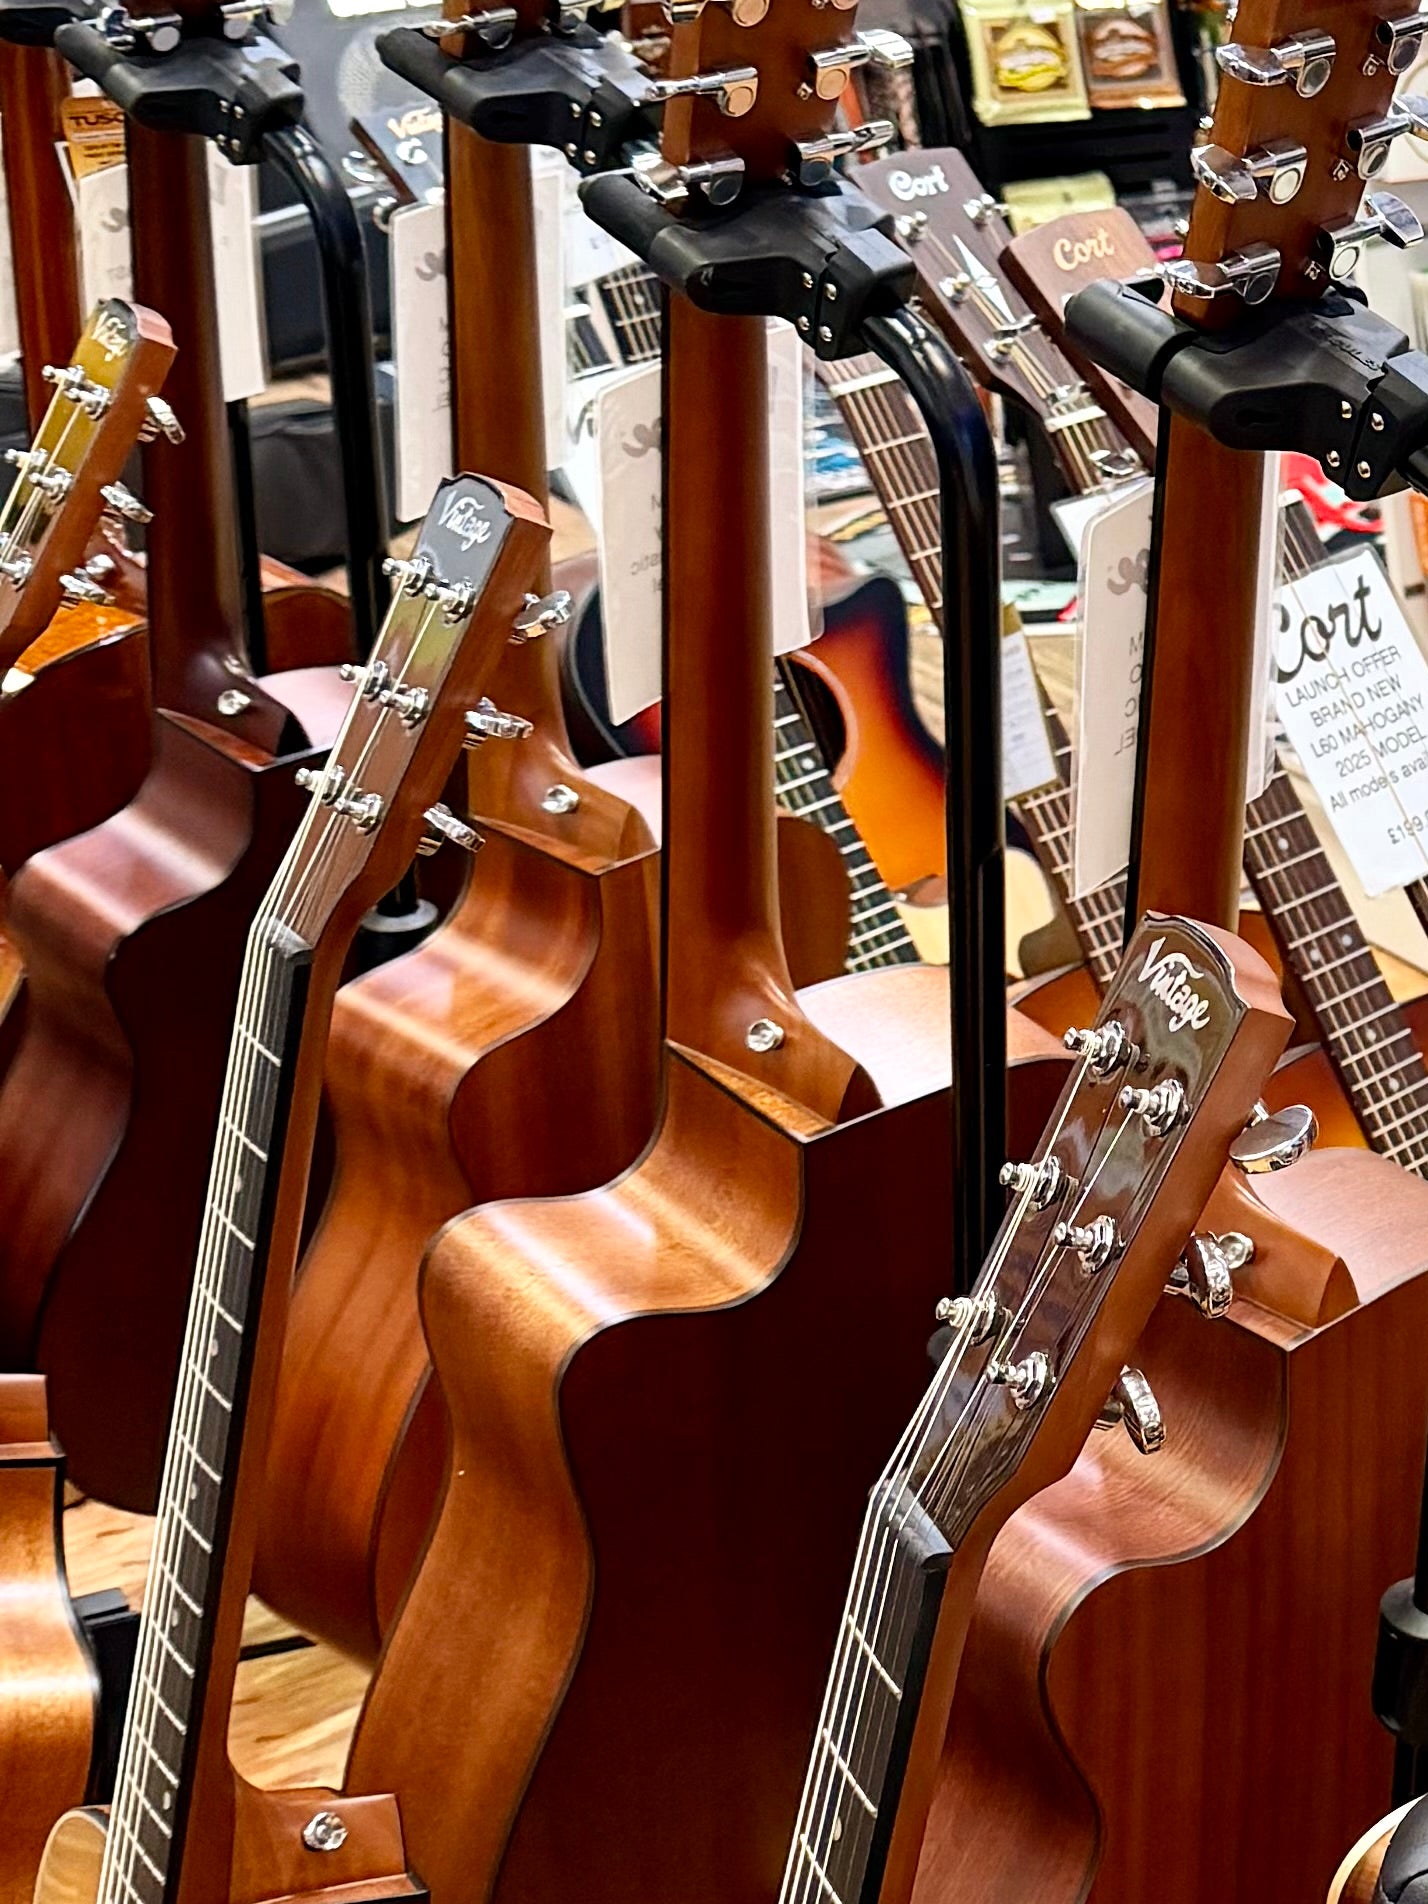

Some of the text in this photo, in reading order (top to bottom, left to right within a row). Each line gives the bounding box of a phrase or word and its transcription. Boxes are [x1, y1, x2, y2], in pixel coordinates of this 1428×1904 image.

[887, 164, 951, 202] Cort
[1051, 227, 1116, 272] Cort
[438, 489, 492, 553] Vintage
[1274, 573, 1384, 685] Cort
[1284, 644, 1402, 709] LAUNCH OFFER
[1309, 674, 1403, 729] BRAND NEW
[1308, 692, 1428, 760] L60 MAHOGANY
[1334, 726, 1428, 779] 2025 MODEL
[1329, 791, 1351, 814] All
[1349, 770, 1401, 805] models
[1137, 936, 1211, 1034] Vintage
